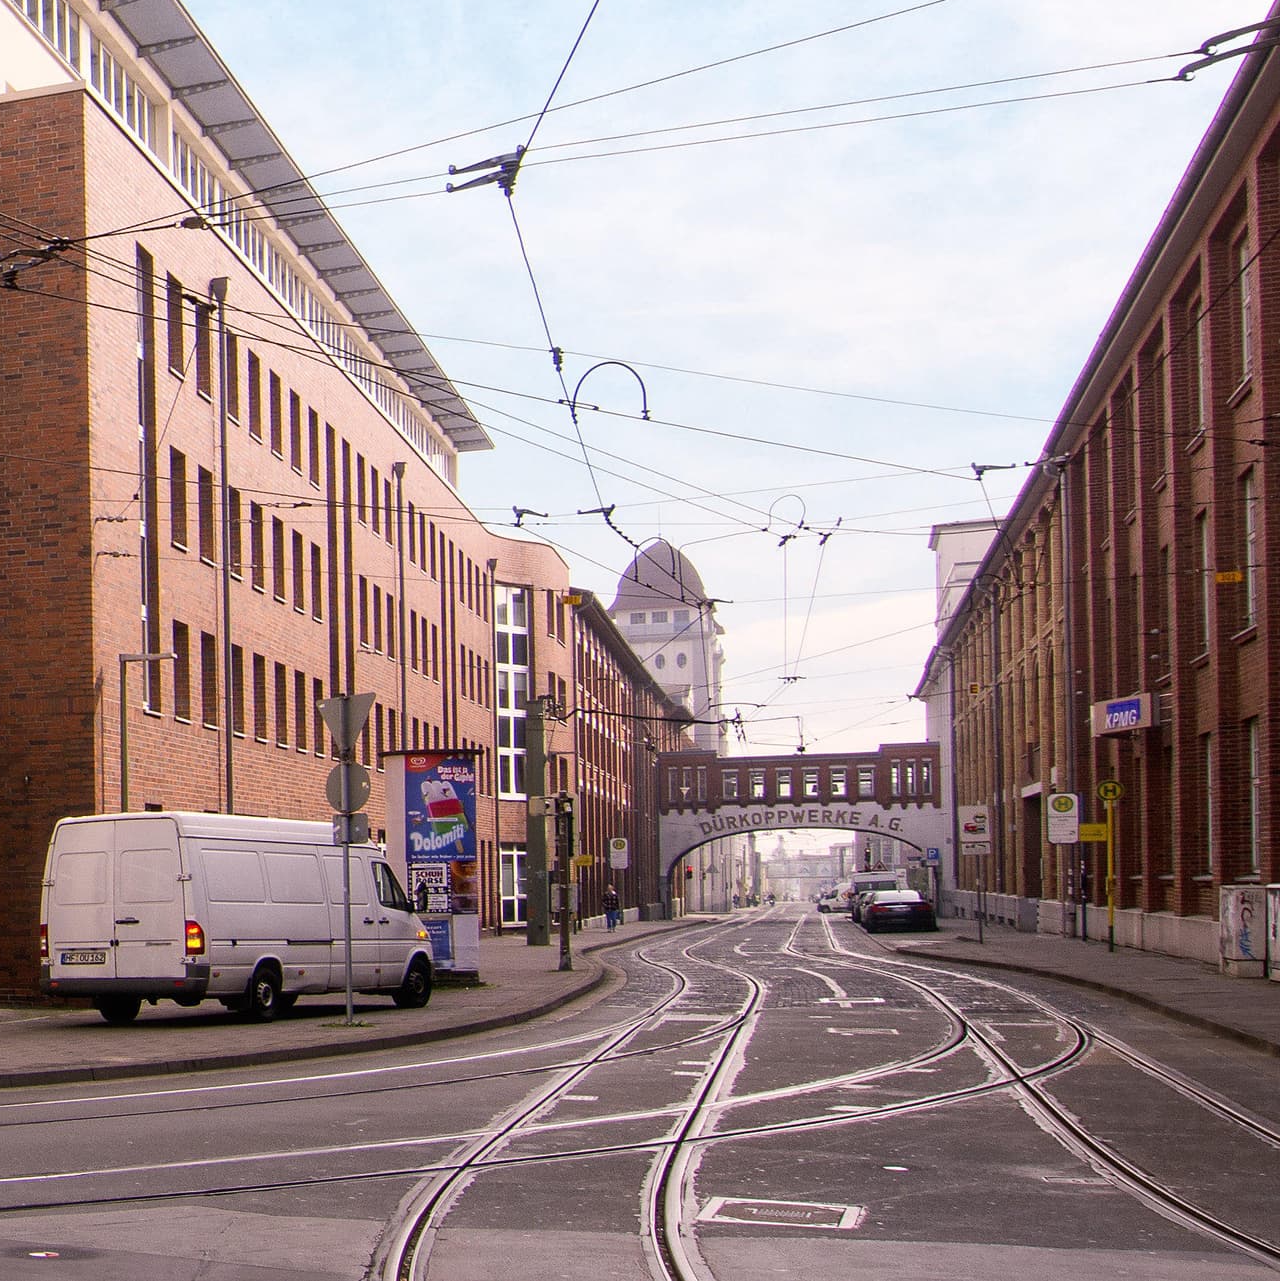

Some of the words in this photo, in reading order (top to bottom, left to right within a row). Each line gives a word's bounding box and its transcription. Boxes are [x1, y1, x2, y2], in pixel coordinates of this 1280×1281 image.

[1105, 709, 1137, 729] KPMG
[1104, 785, 1117, 797] H
[699, 809, 862, 835] DÜRKOPPWERKE
[868, 814, 905, 832] A.G.
[410, 824, 464, 851] Dolomiti
